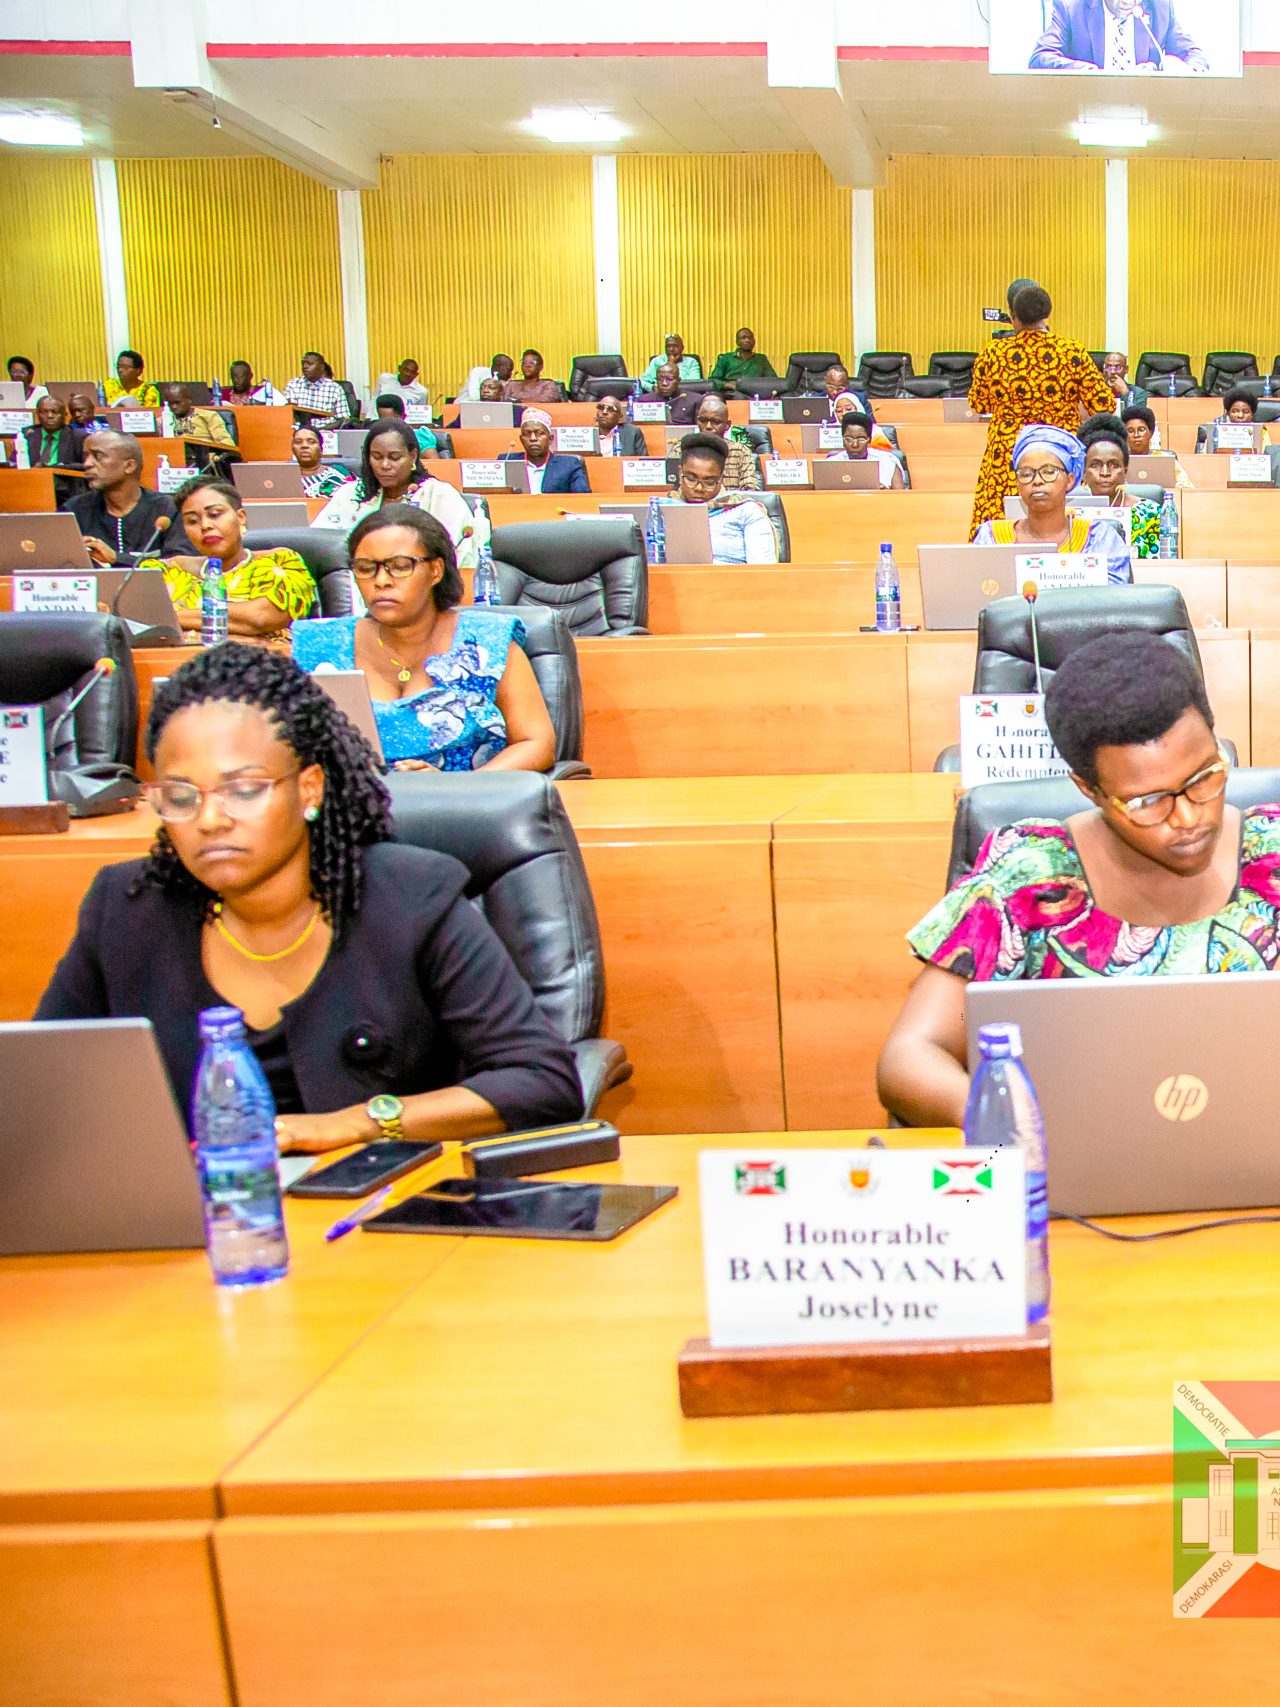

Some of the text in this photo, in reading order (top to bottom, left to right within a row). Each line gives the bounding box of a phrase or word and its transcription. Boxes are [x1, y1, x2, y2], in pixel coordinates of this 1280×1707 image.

[1038, 571, 1087, 580] Honorable
[32, 593, 79, 602] Honorable
[996, 725, 1050, 738] Honora
[784, 1220, 951, 1247] Honorable
[728, 1255, 1007, 1284] BARANYANKA
[797, 1294, 940, 1328] Joselyne
